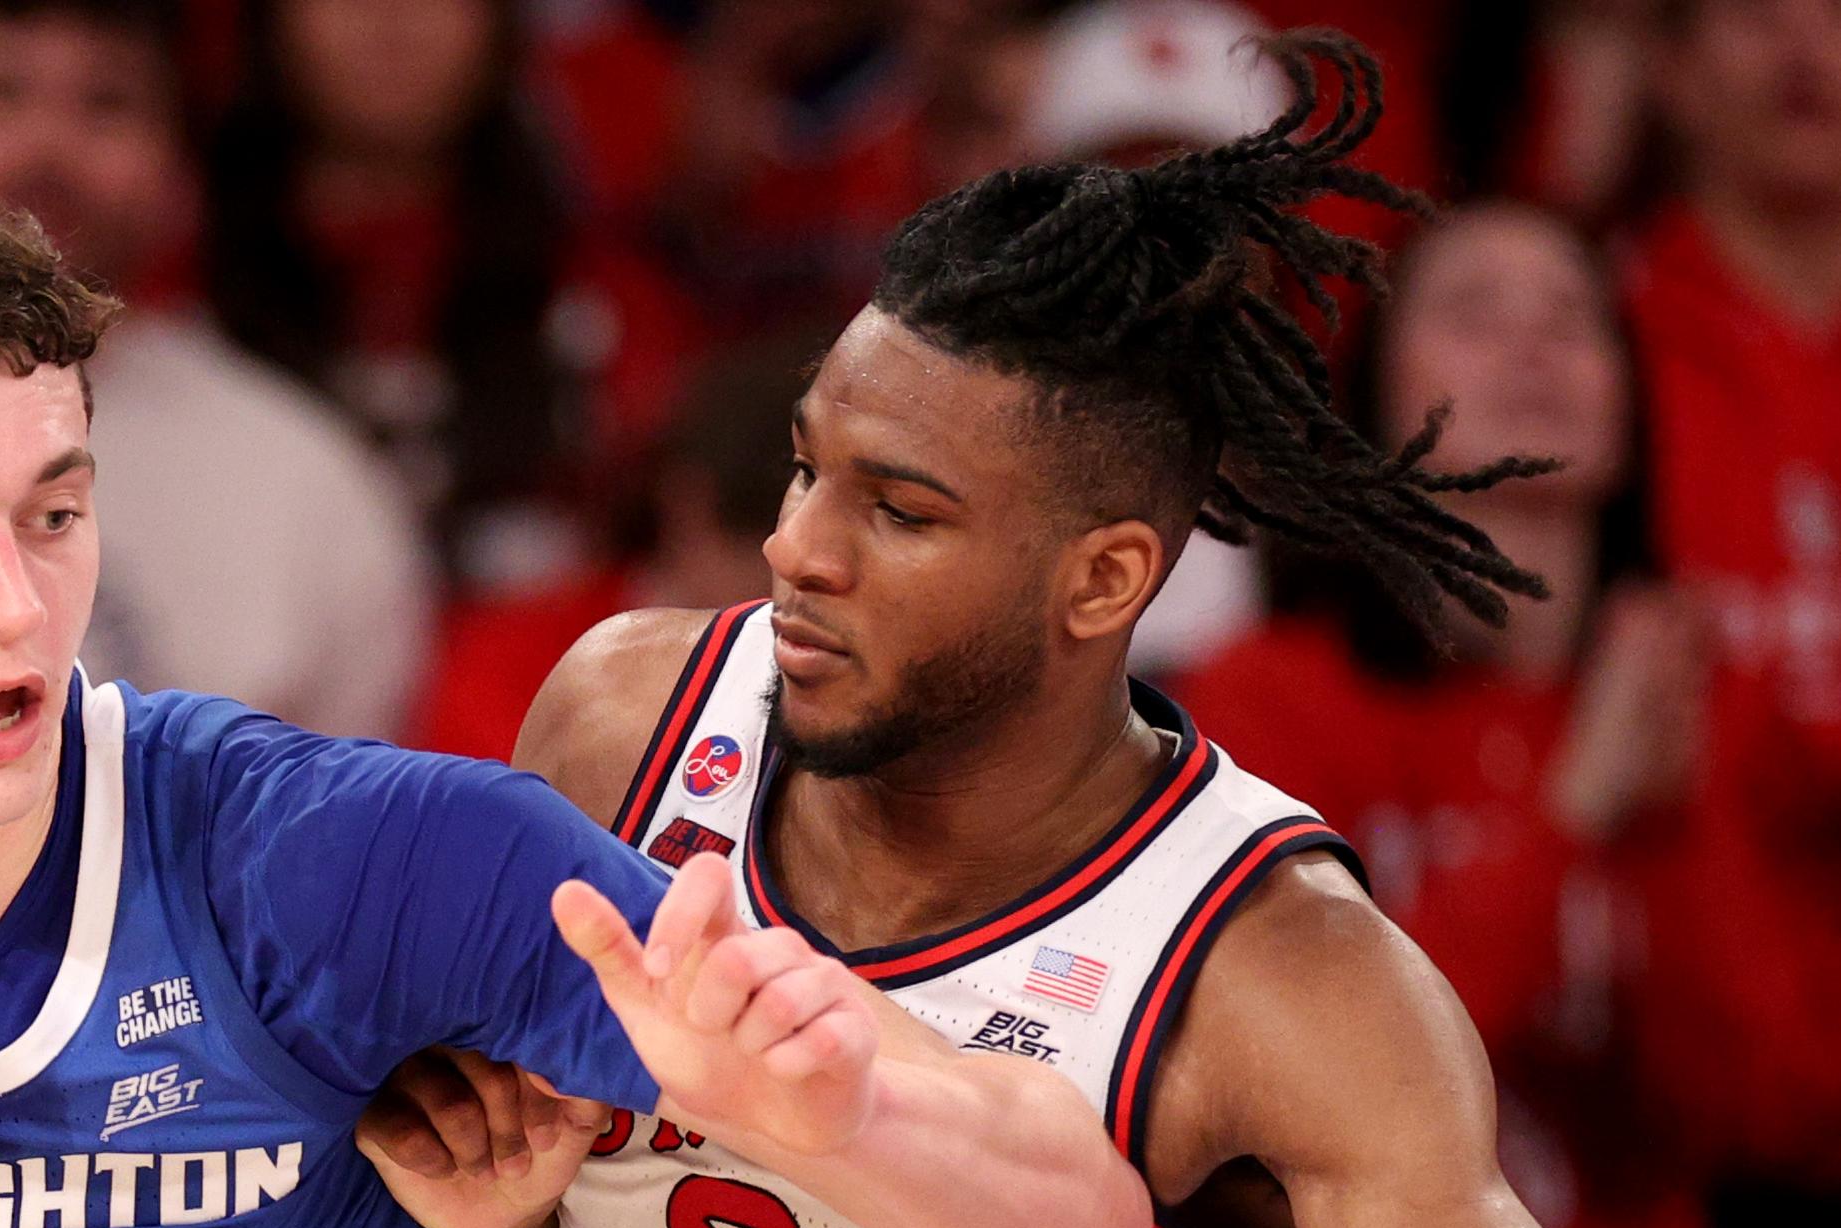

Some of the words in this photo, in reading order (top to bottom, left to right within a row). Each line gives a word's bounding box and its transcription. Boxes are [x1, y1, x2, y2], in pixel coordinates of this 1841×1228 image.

[685, 745, 734, 785] Lou
[650, 836, 696, 867] CHA
[664, 818, 693, 841] BE
[691, 827, 732, 855] THE
[119, 989, 146, 1021] BE
[150, 976, 194, 1008] THE
[116, 1000, 202, 1048] CHANGE
[985, 1010, 1050, 1039] BIG
[971, 1027, 1060, 1061] EAST
[105, 1079, 204, 1124] EAST
[110, 1063, 179, 1102] BIG
